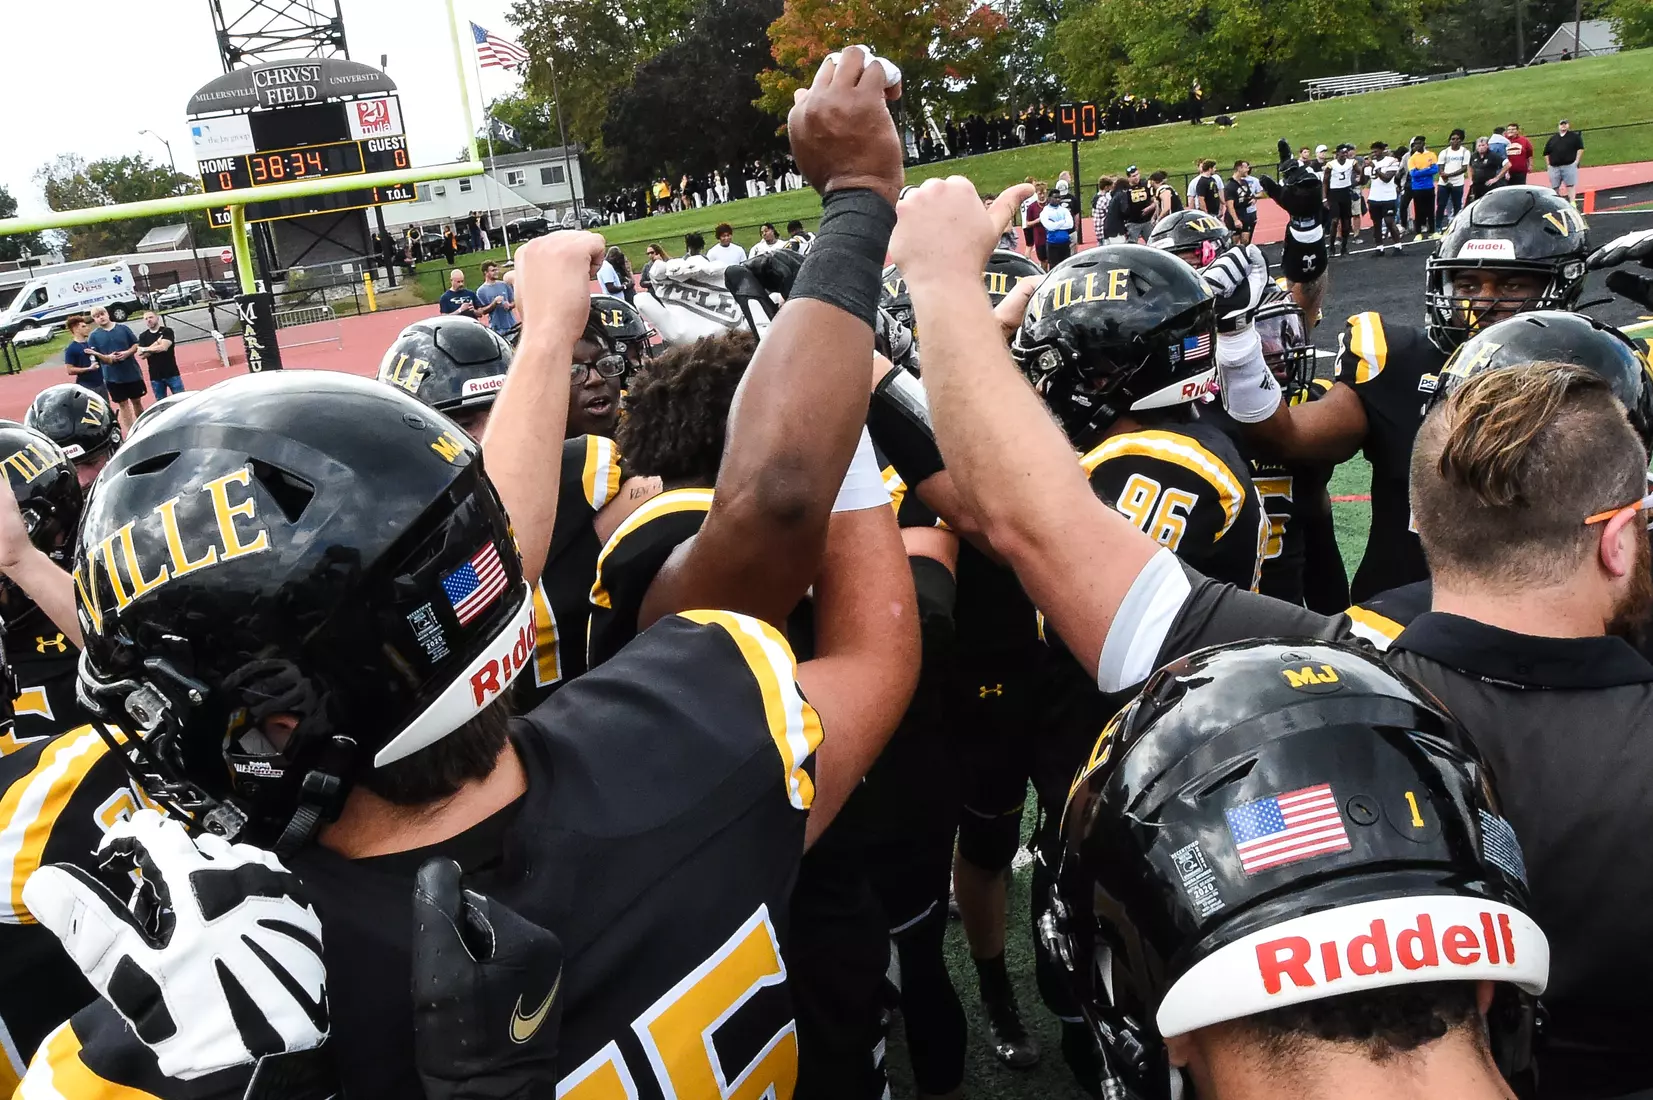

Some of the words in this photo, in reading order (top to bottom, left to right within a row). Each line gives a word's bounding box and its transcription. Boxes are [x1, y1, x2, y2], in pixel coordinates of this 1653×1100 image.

[255, 66, 321, 88] CHRYST
[330, 72, 380, 85] UNIVERSITY
[195, 87, 256, 102] MILLERSVILLE
[267, 84, 317, 105] FIELD
[1062, 105, 1096, 136] 40
[368, 136, 406, 152] GUEST
[199, 158, 236, 174] HOME
[394, 149, 406, 167] 0
[219, 171, 233, 190] 0
[1031, 268, 1130, 320] VILLE
[1116, 473, 1199, 553] 96
[74, 467, 270, 635] VILLE
[1282, 664, 1340, 688] MJ
[1404, 791, 1425, 828] 1
[1193, 882, 1214, 899] 2020
[1255, 912, 1516, 994] Riddell
